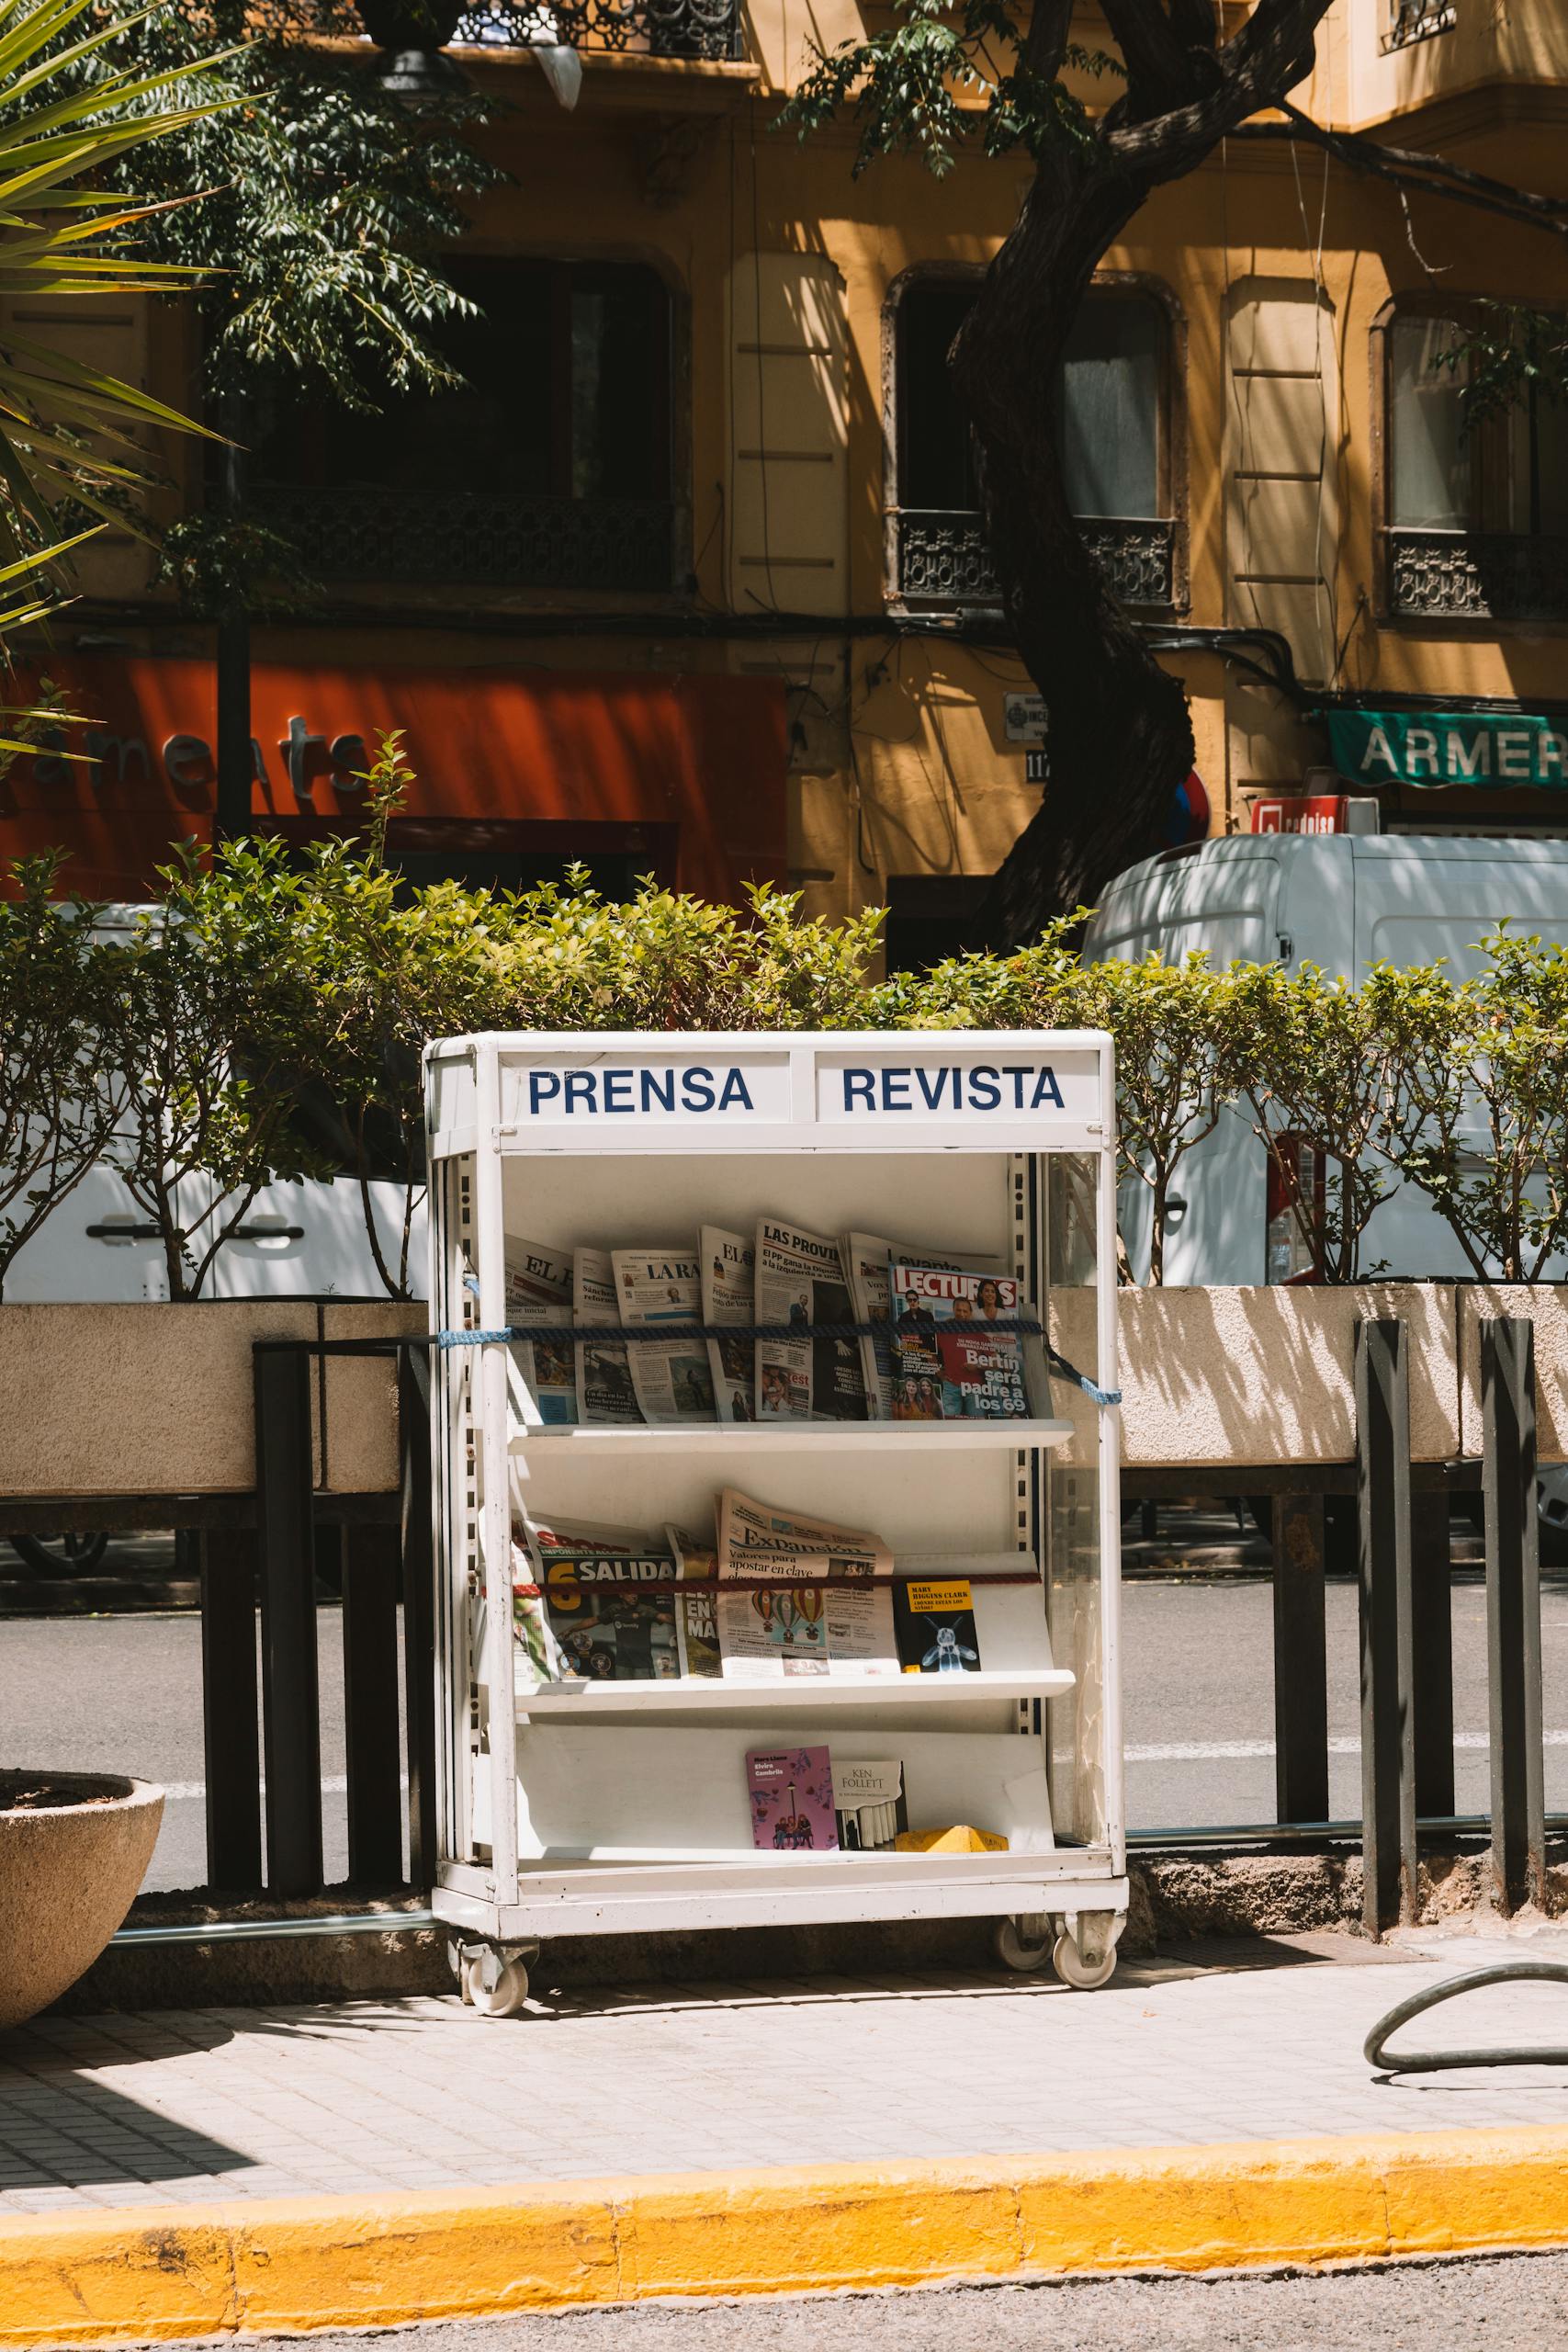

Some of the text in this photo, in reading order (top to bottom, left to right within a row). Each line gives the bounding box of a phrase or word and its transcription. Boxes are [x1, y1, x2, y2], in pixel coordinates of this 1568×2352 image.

[529, 1067, 754, 1114] PRENSA
[842, 1066, 1066, 1112] REVISTA
[763, 1225, 790, 1246] LAS
[722, 1243, 742, 1265] EL
[772, 1252, 783, 1261] PP
[525, 1255, 558, 1283] EL
[896, 1265, 1016, 1307] LECTURS
[965, 1349, 1021, 1370] Bertín
[984, 1368, 1021, 1385] será
[960, 1380, 1024, 1399] padre a
[974, 1394, 1027, 1412] los 69
[744, 1526, 862, 1554] Expansión
[729, 1549, 796, 1564] Valores para
[728, 1560, 770, 1574] apostar
[771, 1565, 784, 1573] en
[785, 1566, 813, 1578] clave
[546, 1562, 581, 1611] 6
[842, 1778, 884, 1789] FOLLETT
[852, 1769, 872, 1778] KEN
